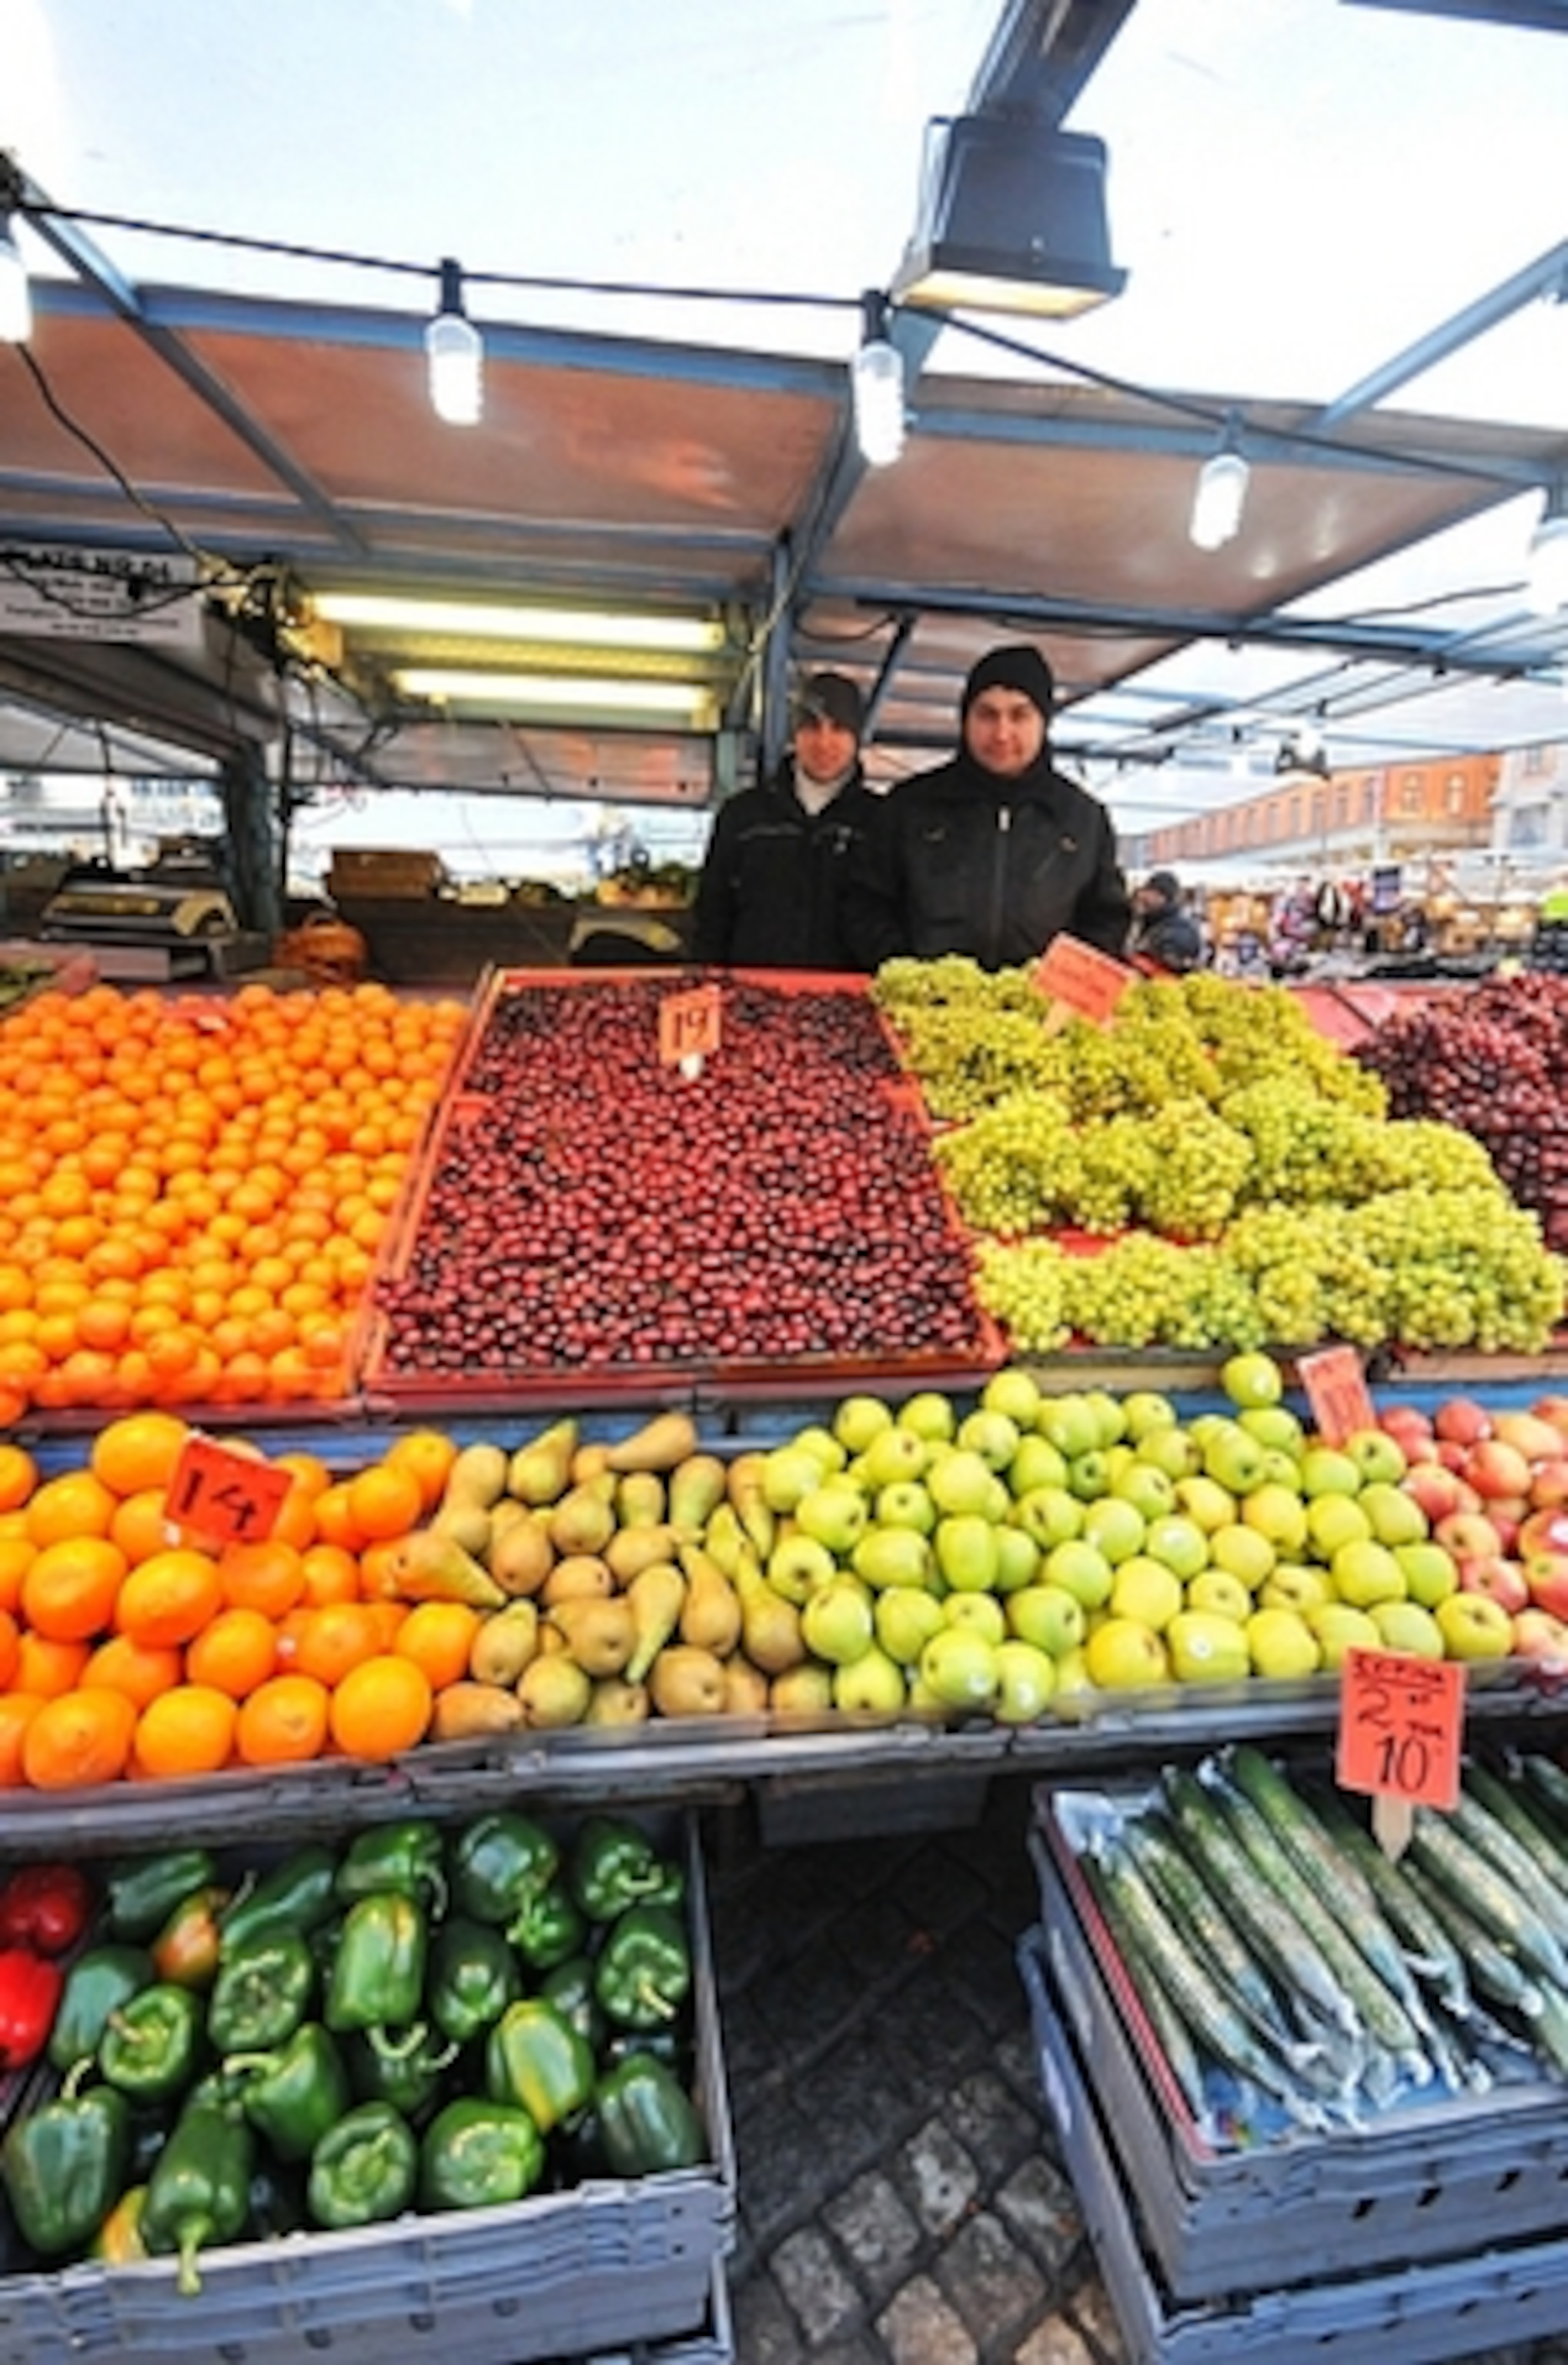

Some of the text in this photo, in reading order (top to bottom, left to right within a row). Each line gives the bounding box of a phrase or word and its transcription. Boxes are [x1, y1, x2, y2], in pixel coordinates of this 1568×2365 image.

[674, 1007, 707, 1049] 19
[180, 1470, 258, 1532] 14
[1358, 1687, 1395, 1729] 2
[1374, 1735, 1431, 1793] 10
